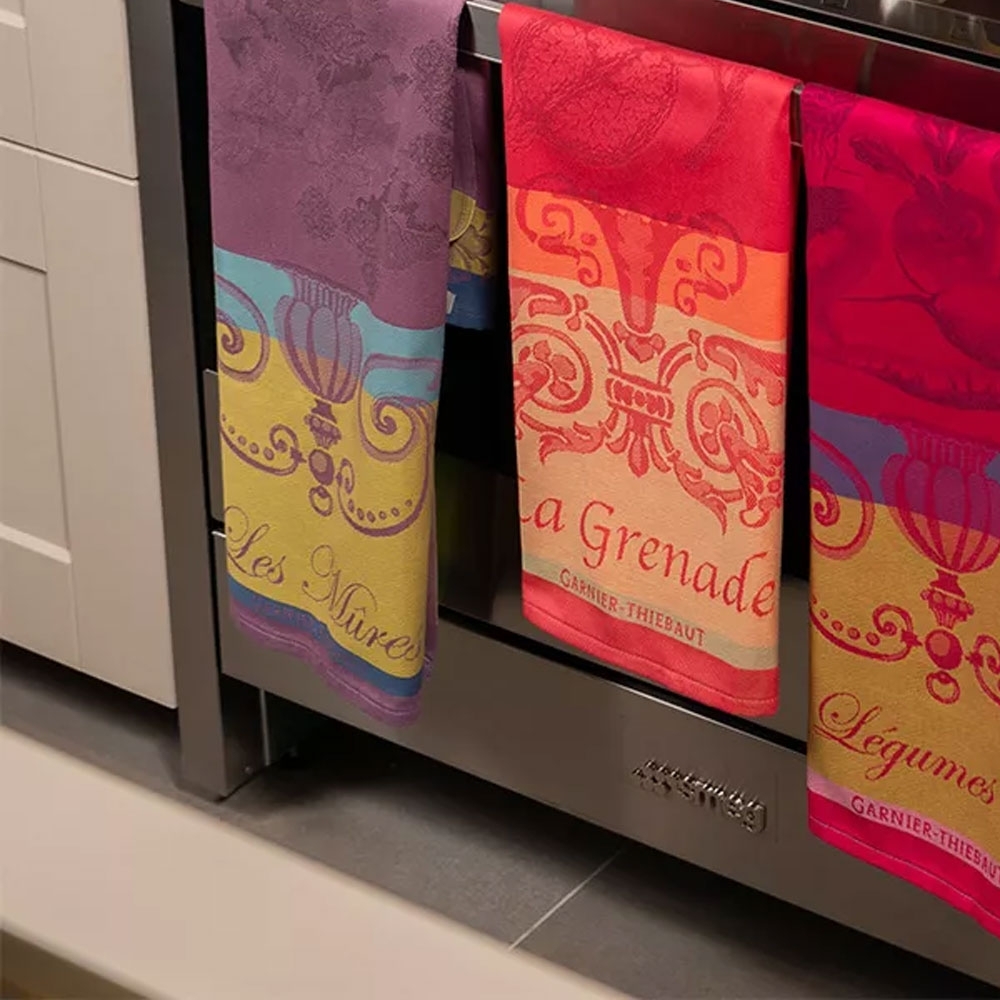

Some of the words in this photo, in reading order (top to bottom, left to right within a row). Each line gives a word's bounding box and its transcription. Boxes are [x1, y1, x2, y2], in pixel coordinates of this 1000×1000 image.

[224, 505, 287, 585] Les
[518, 480, 566, 533] a
[579, 500, 776, 618] Grenade
[559, 568, 706, 647] GARNIER-THIEBAUT
[813, 692, 997, 806] Légumes
